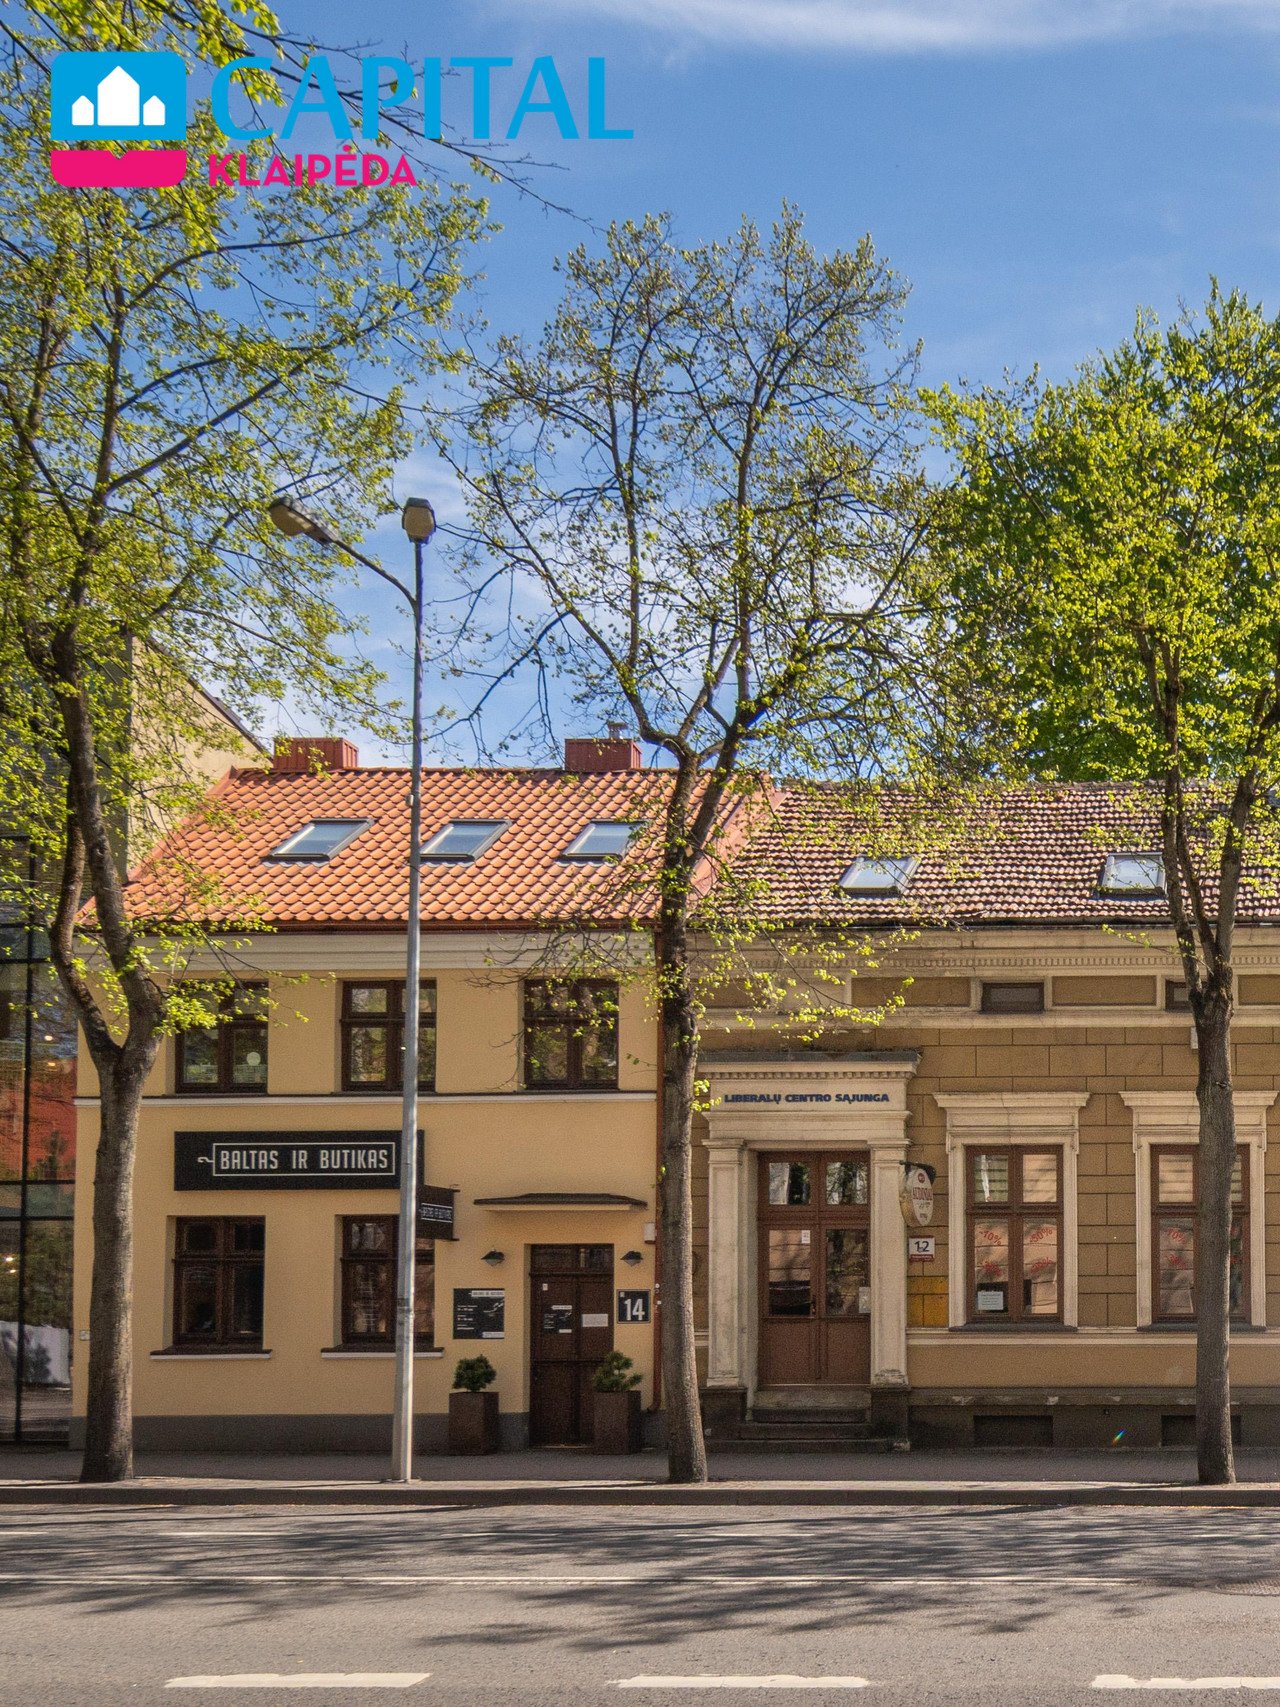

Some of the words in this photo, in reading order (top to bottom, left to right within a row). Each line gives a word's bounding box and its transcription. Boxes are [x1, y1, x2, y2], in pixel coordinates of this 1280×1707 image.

[724, 1093, 782, 1105] LIBERALŲ
[785, 1093, 832, 1103] CENTRO
[835, 1093, 890, 1105] SĄJUNGA
[220, 1150, 279, 1170] BALTAS
[292, 1150, 308, 1169] IR
[320, 1149, 388, 1169] BUTIKAS
[914, 1240, 930, 1253] 12
[623, 1298, 646, 1321] 14
